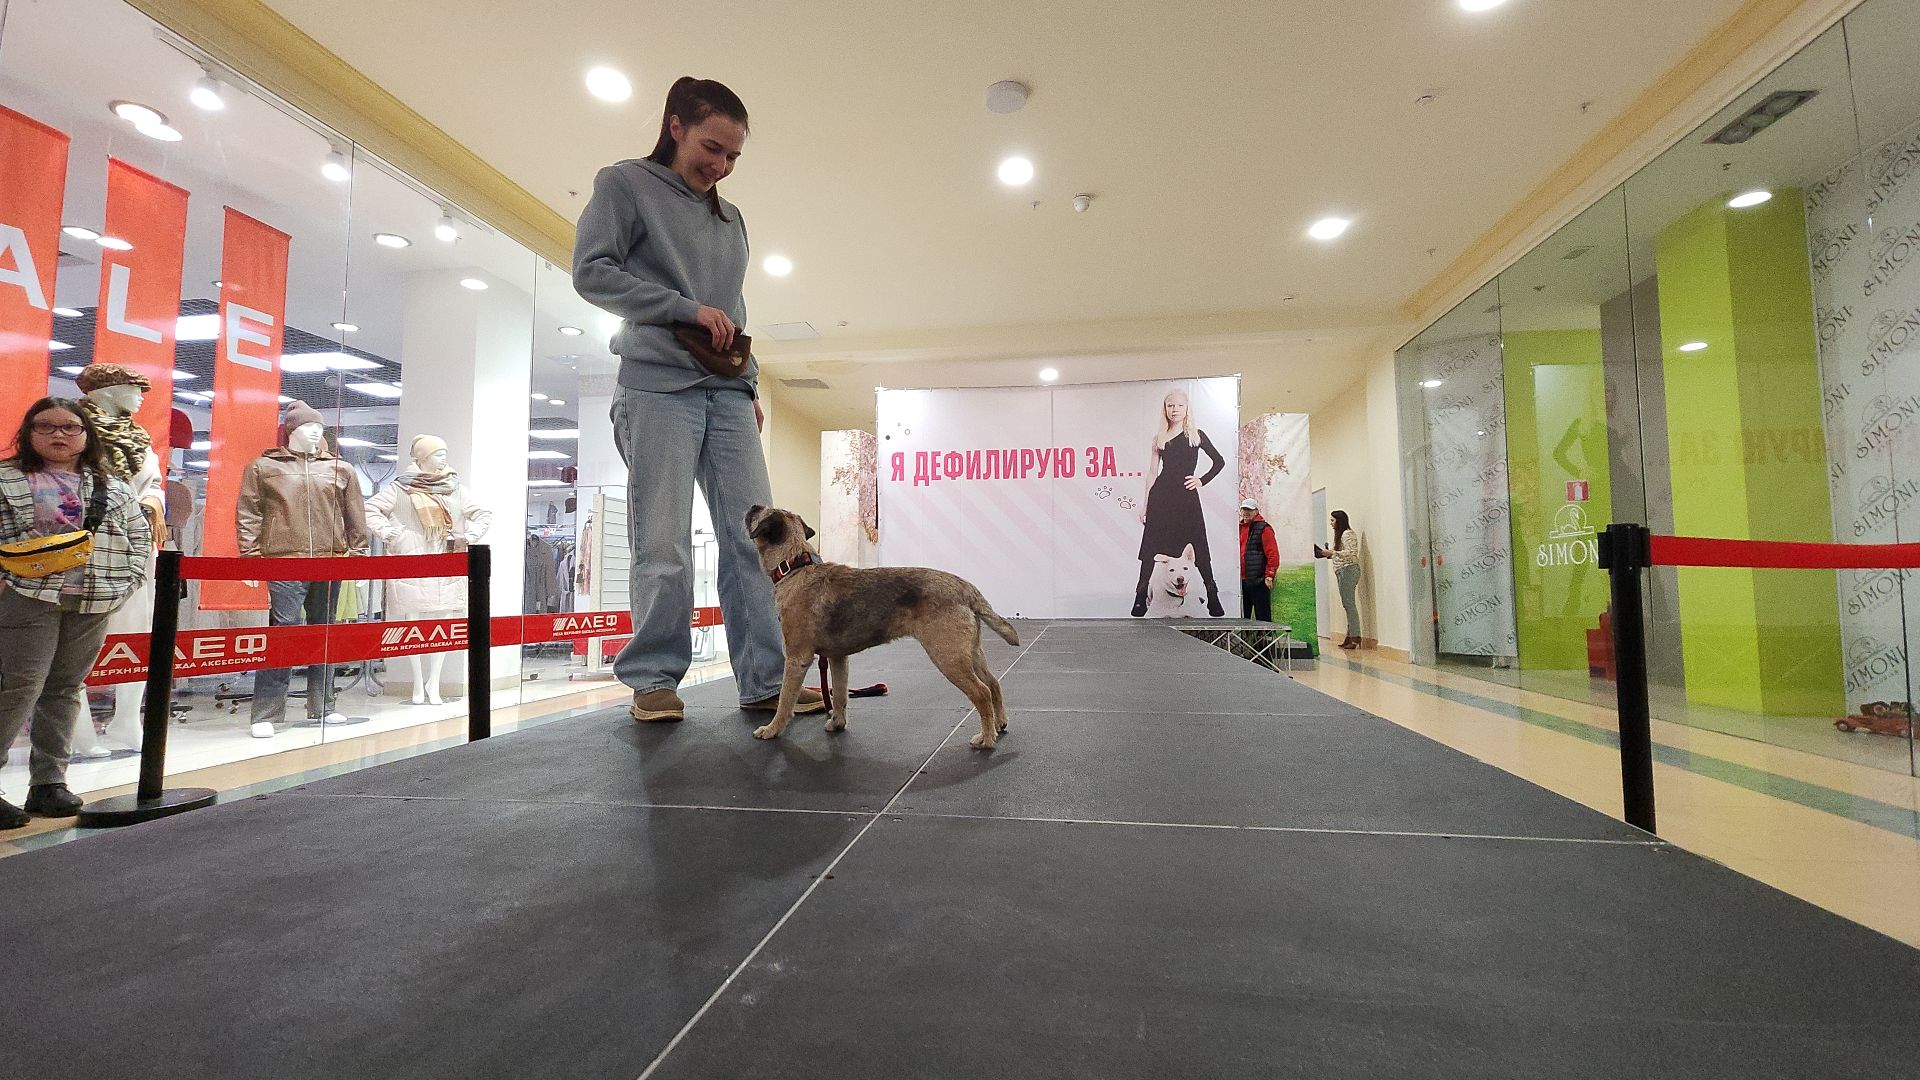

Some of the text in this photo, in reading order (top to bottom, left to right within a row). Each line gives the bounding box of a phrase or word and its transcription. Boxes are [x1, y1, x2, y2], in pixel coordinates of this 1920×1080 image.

[1814, 223, 1857, 276] MONI
[1864, 222, 1920, 297] SIMON
[1857, 395, 1920, 459] SIMONI
[891, 452, 905, 482] Я
[914, 447, 1076, 487] ДЕФИЛИРУЮ
[1465, 500, 1509, 534] SIMON
[1853, 479, 1919, 537] SIMONI
[1461, 548, 1509, 580] SIMONI
[1537, 539, 1599, 567] SIMON
[566, 615, 617, 631] АЛЕФ
[1455, 595, 1502, 627] SIMONI
[99, 633, 267, 667] АЕФ
[404, 623, 468, 643] АЛЕ
[200, 656, 266, 667] АКСЕССУАРЫ
